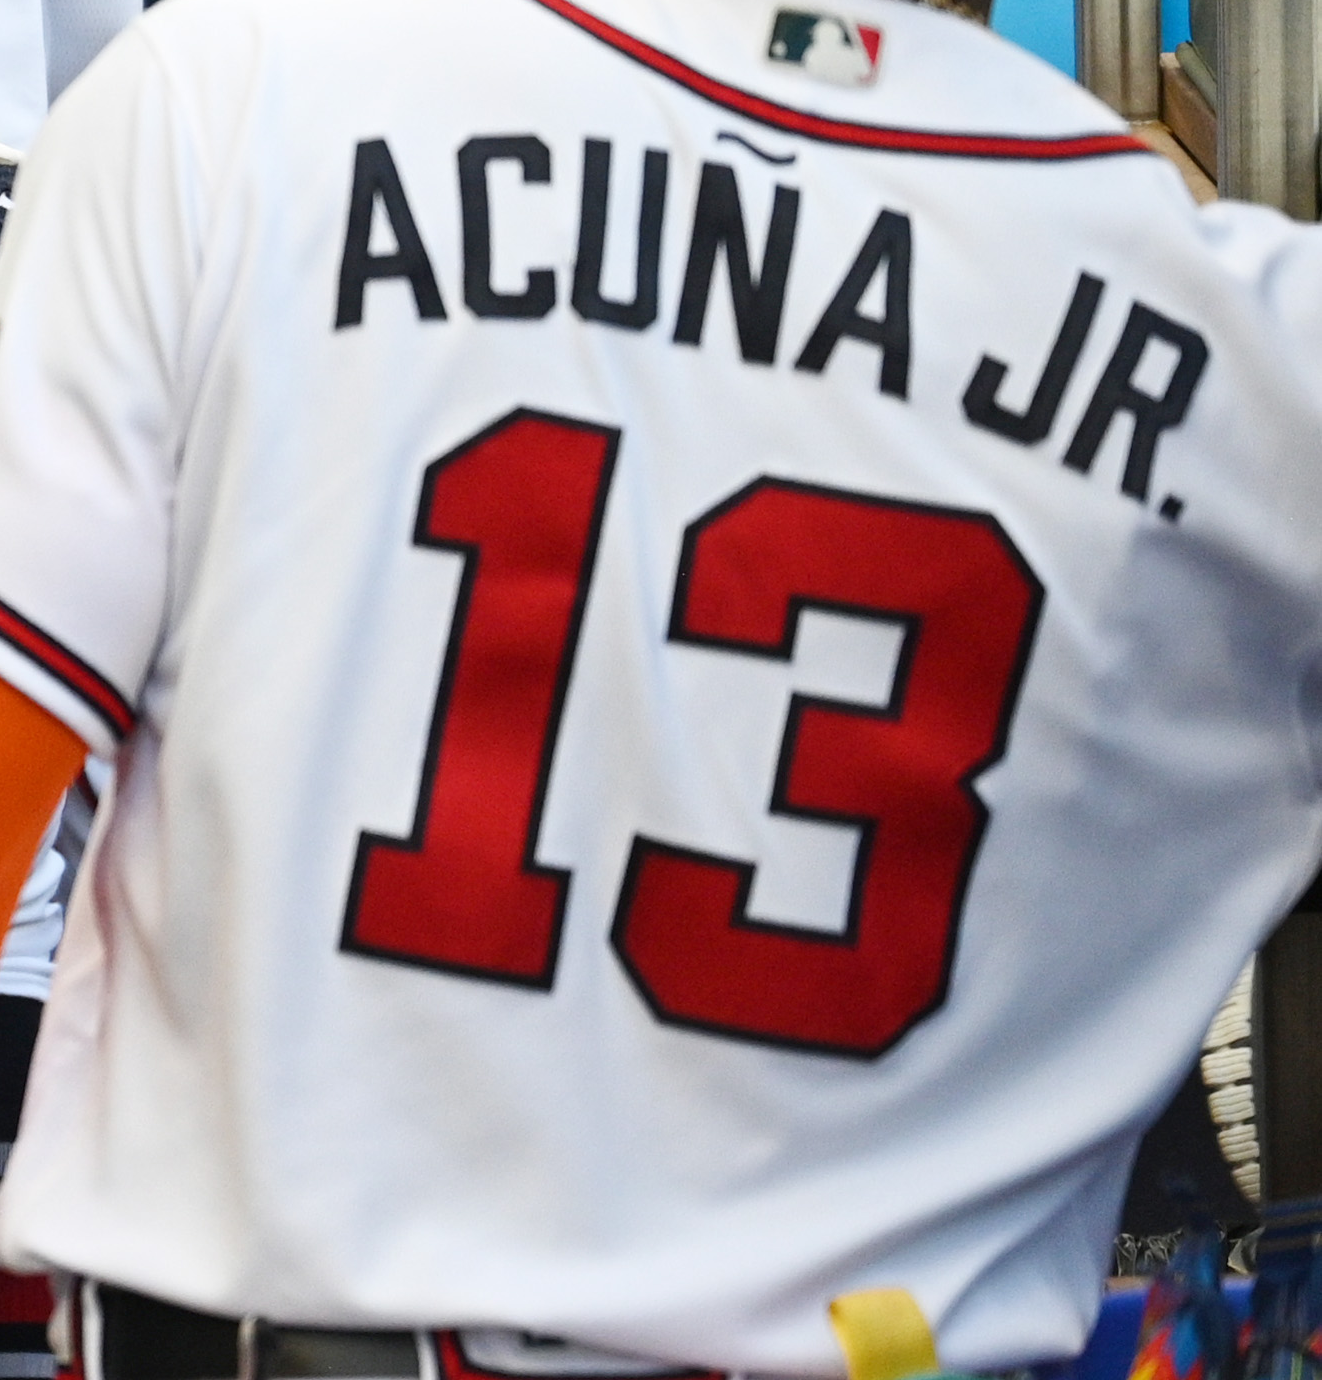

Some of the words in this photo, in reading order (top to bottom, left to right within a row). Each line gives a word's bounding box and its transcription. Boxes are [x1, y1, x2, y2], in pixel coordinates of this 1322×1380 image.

[332, 132, 916, 404] ACUÑA
[960, 270, 1210, 525] JR.
[338, 406, 1047, 1062] 13
